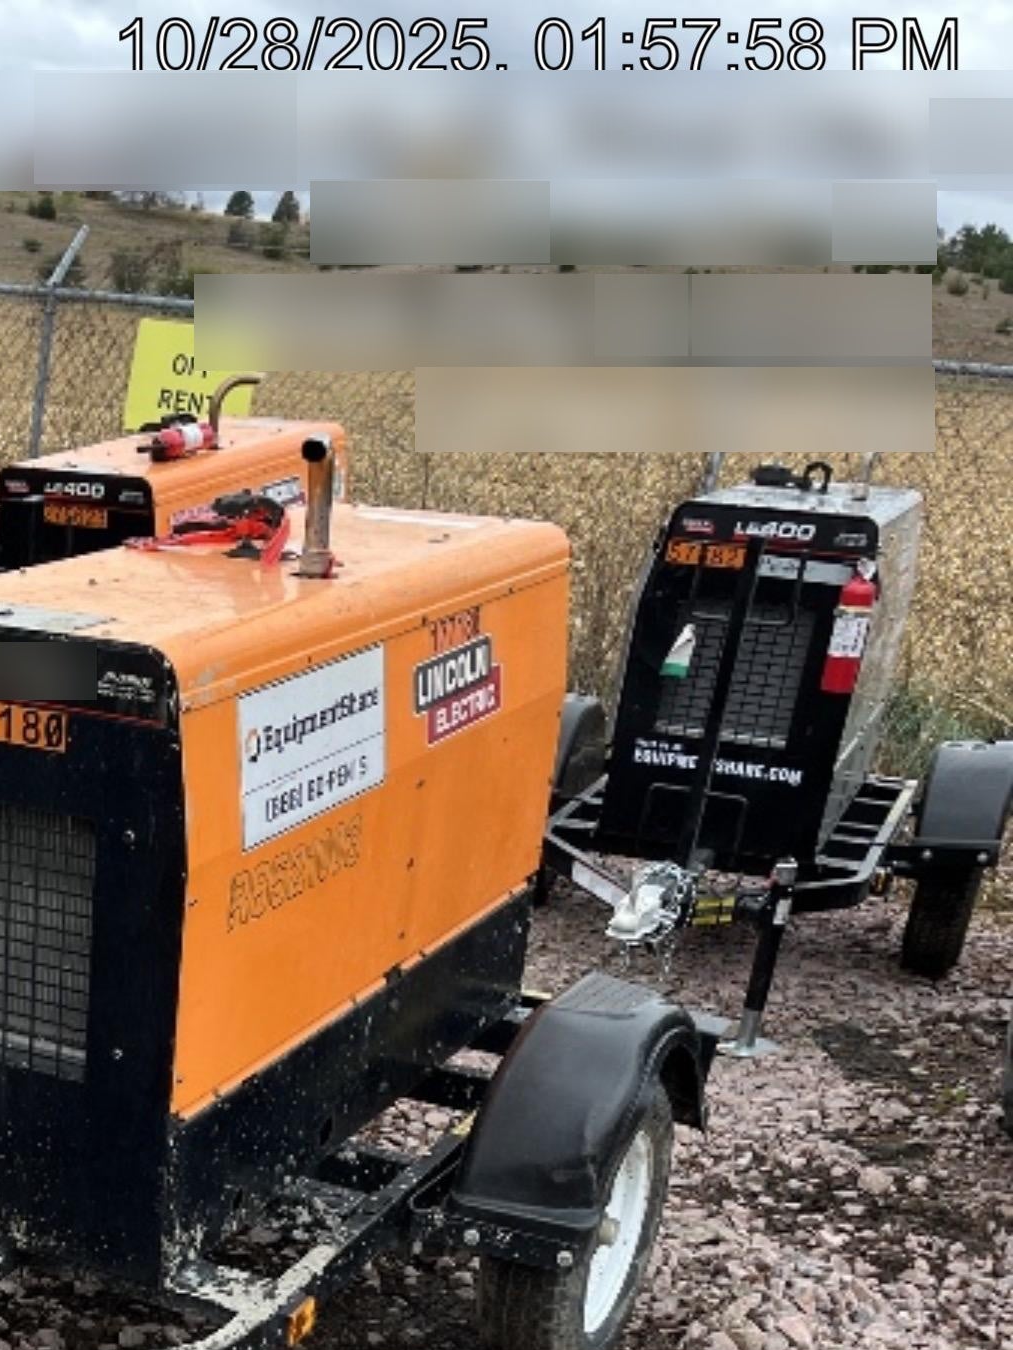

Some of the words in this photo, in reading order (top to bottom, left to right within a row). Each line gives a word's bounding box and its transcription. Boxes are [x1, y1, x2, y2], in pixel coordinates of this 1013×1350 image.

[418, 645, 490, 706] LINCOLN
[262, 687, 379, 753] EquipmentShare
[436, 684, 496, 733] ELECTRIC
[634, 748, 802, 786] EQUIPMESHARE.COM
